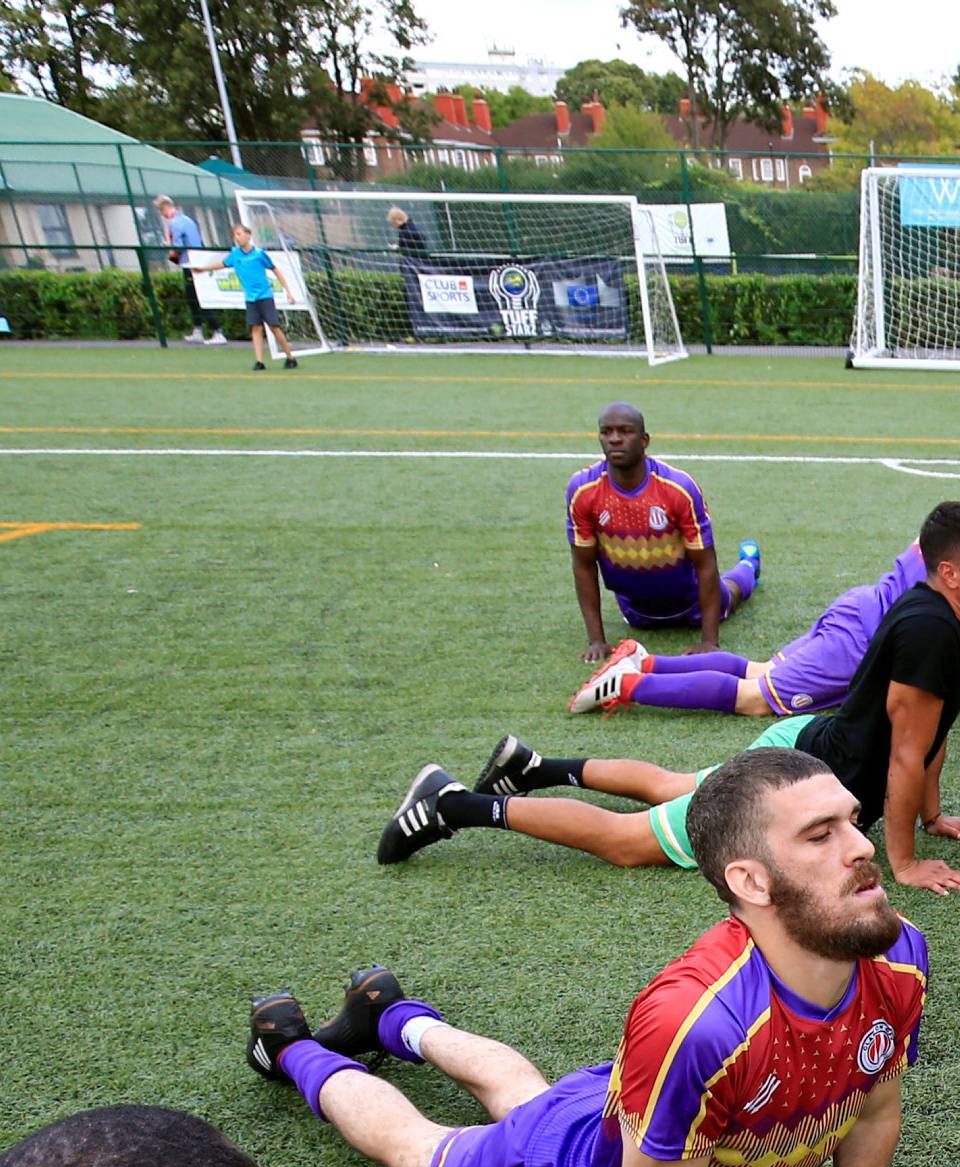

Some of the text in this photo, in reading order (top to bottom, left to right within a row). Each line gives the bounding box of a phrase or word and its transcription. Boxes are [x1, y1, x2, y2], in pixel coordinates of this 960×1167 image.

[424, 279, 457, 290] CLUB
[427, 291, 471, 303] SPORTS
[500, 309, 538, 324] TUFF
[505, 324, 538, 336] STARZ
